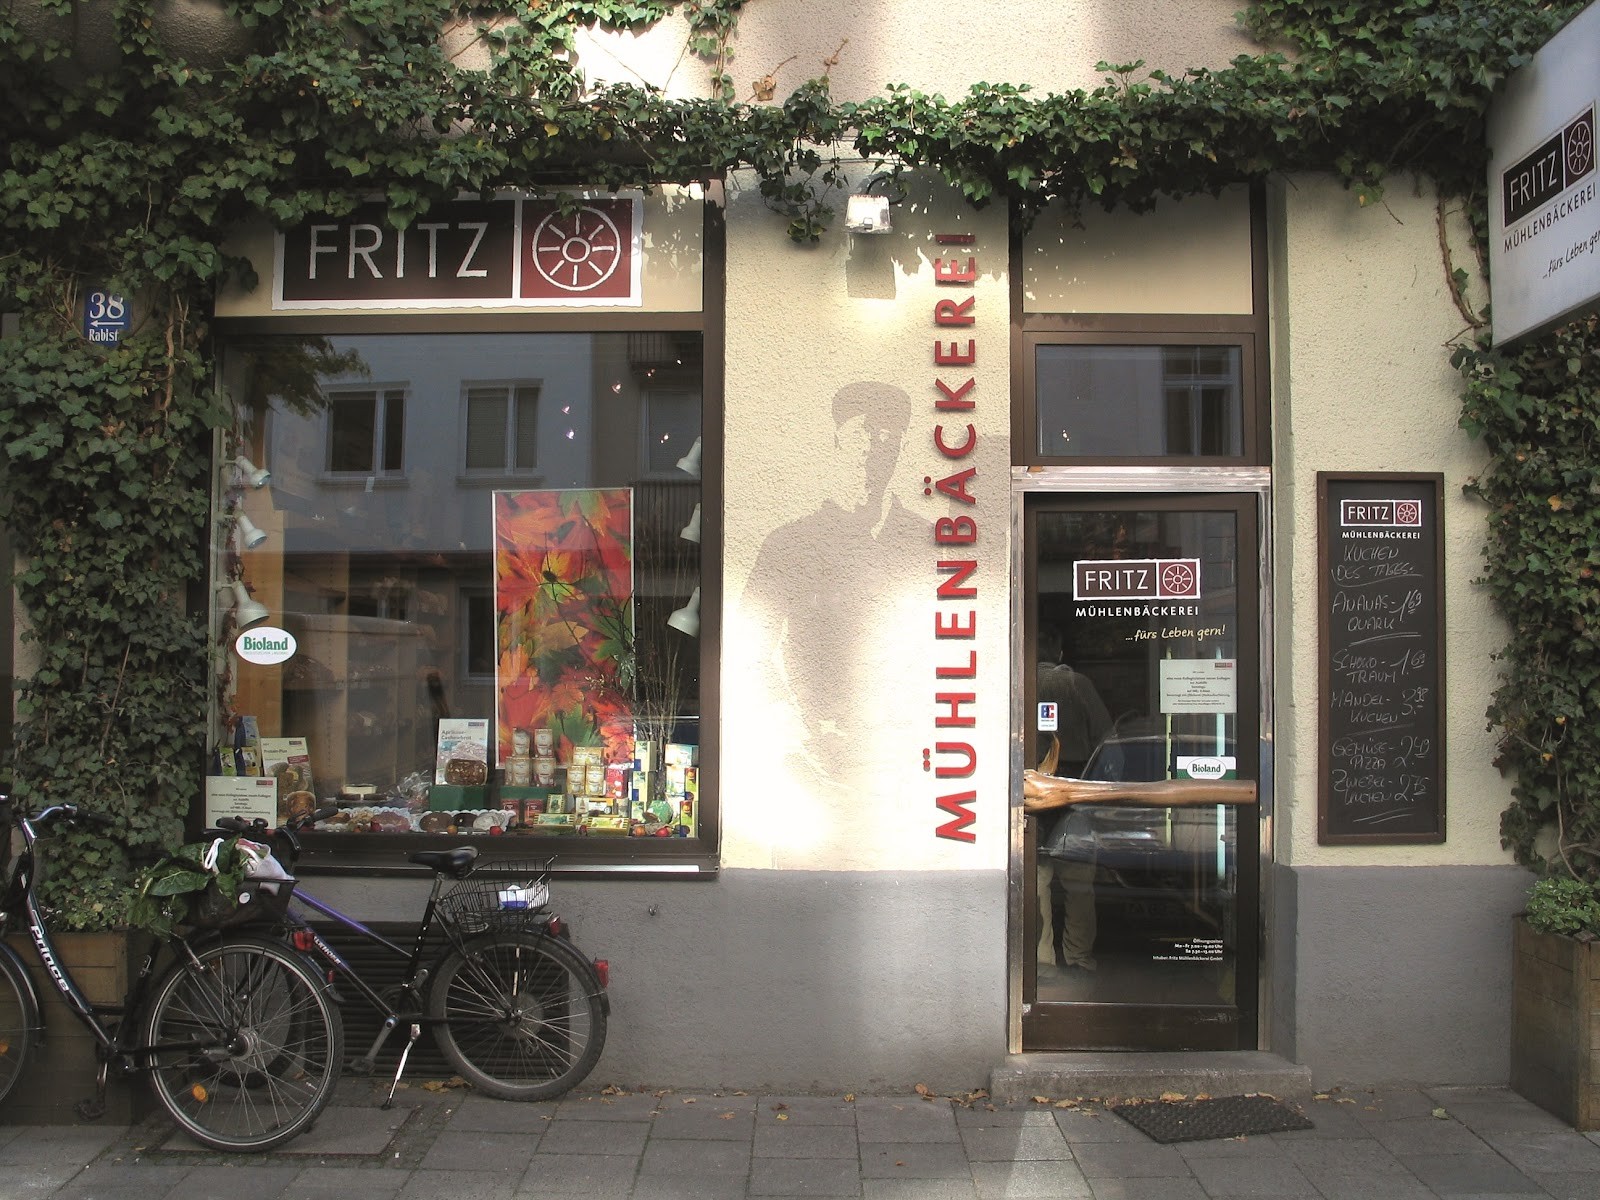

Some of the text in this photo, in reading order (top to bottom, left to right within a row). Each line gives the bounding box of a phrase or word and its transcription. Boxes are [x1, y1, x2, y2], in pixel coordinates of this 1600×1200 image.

[1509, 150, 1558, 213] FRITZ
[1503, 182, 1597, 253] MÜHLENBÄCKEREI
[308, 222, 489, 280] FRITZ
[89, 292, 125, 319] 38
[1347, 506, 1389, 520] FRITZ
[922, 234, 977, 843] MÜHLENBÄCKEREI
[1341, 530, 1421, 540] MÜHLENBÄCKEREI
[1343, 544, 1399, 562] KUCHEN
[1084, 569, 1149, 591] FRITZ
[1336, 564, 1365, 581] DES
[1075, 605, 1199, 617] MÜHLENBÄCKEREI
[1347, 616, 1395, 632] QUARK
[1161, 626, 1194, 639] Leben
[1197, 624, 1226, 642] gern!
[243, 636, 289, 651] Bioland
[1346, 670, 1397, 684] TRAUM
[1350, 710, 1398, 724] KUCHEN
[1192, 764, 1221, 773] Bioland
[1349, 755, 1387, 770] PIZZA
[30, 925, 70, 992] Prince
